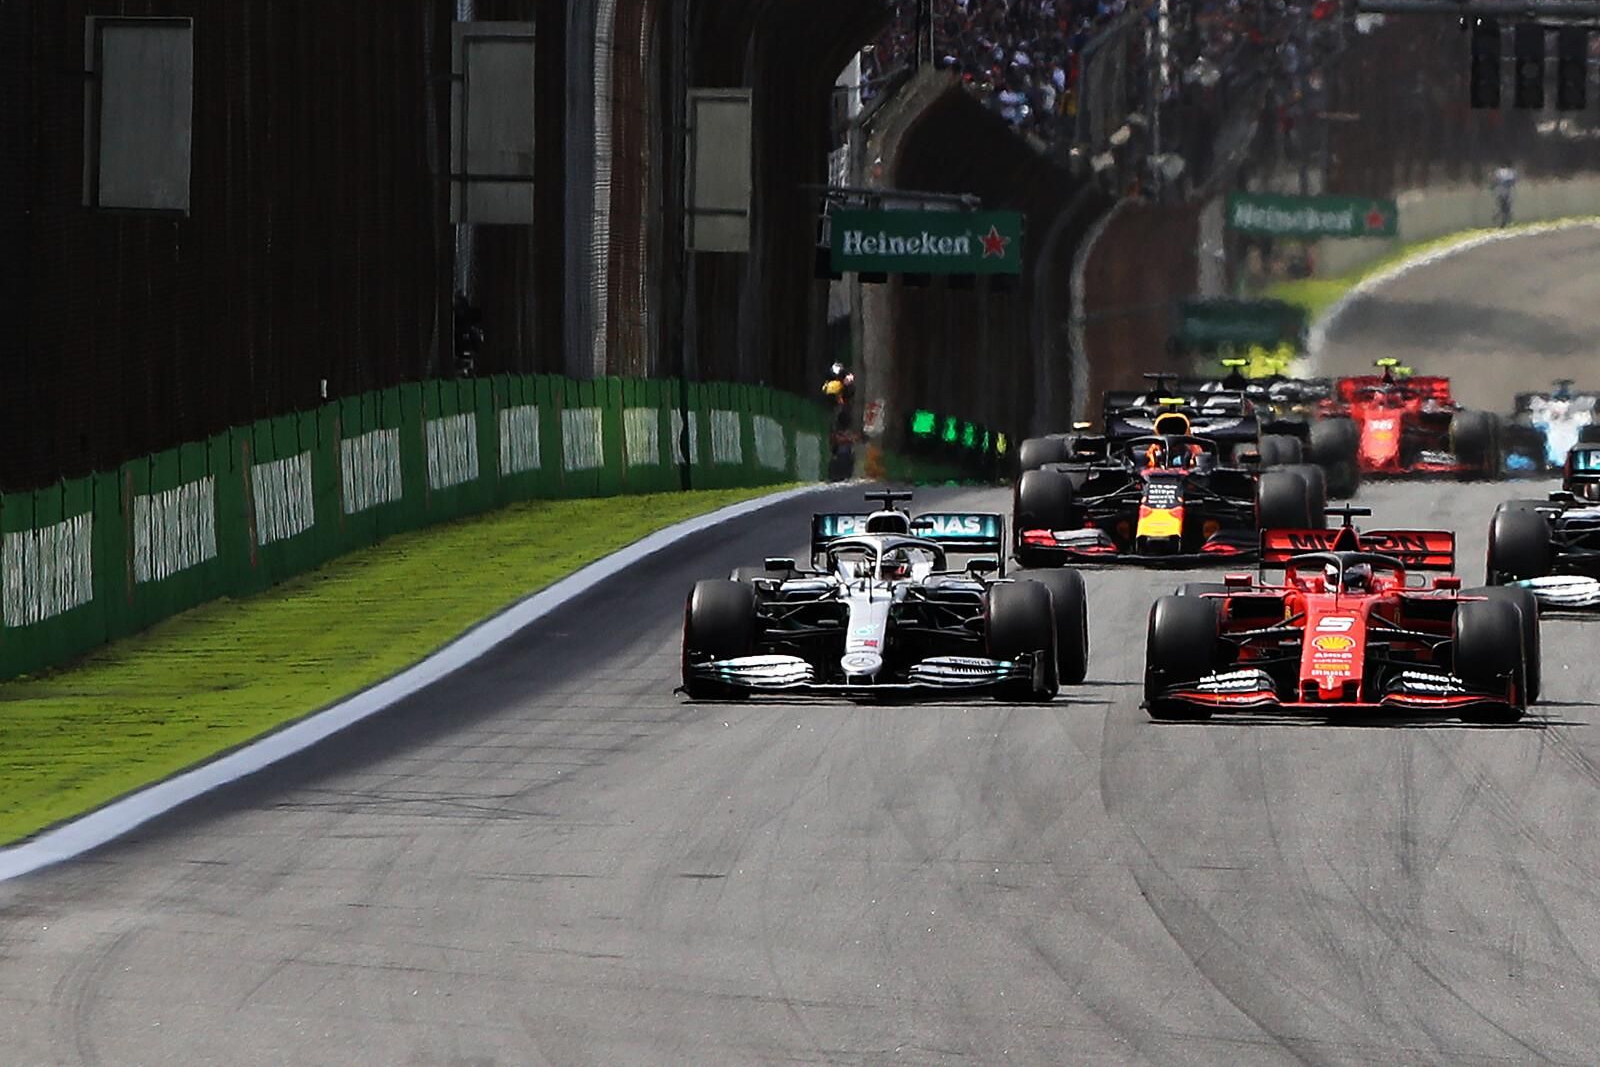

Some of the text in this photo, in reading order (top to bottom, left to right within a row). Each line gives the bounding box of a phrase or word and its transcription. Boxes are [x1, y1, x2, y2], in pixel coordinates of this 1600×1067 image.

[842, 229, 972, 256] Heineken
[836, 516, 982, 535] PENAS
[1287, 533, 1430, 552] MION
[1314, 615, 1357, 633] 5
